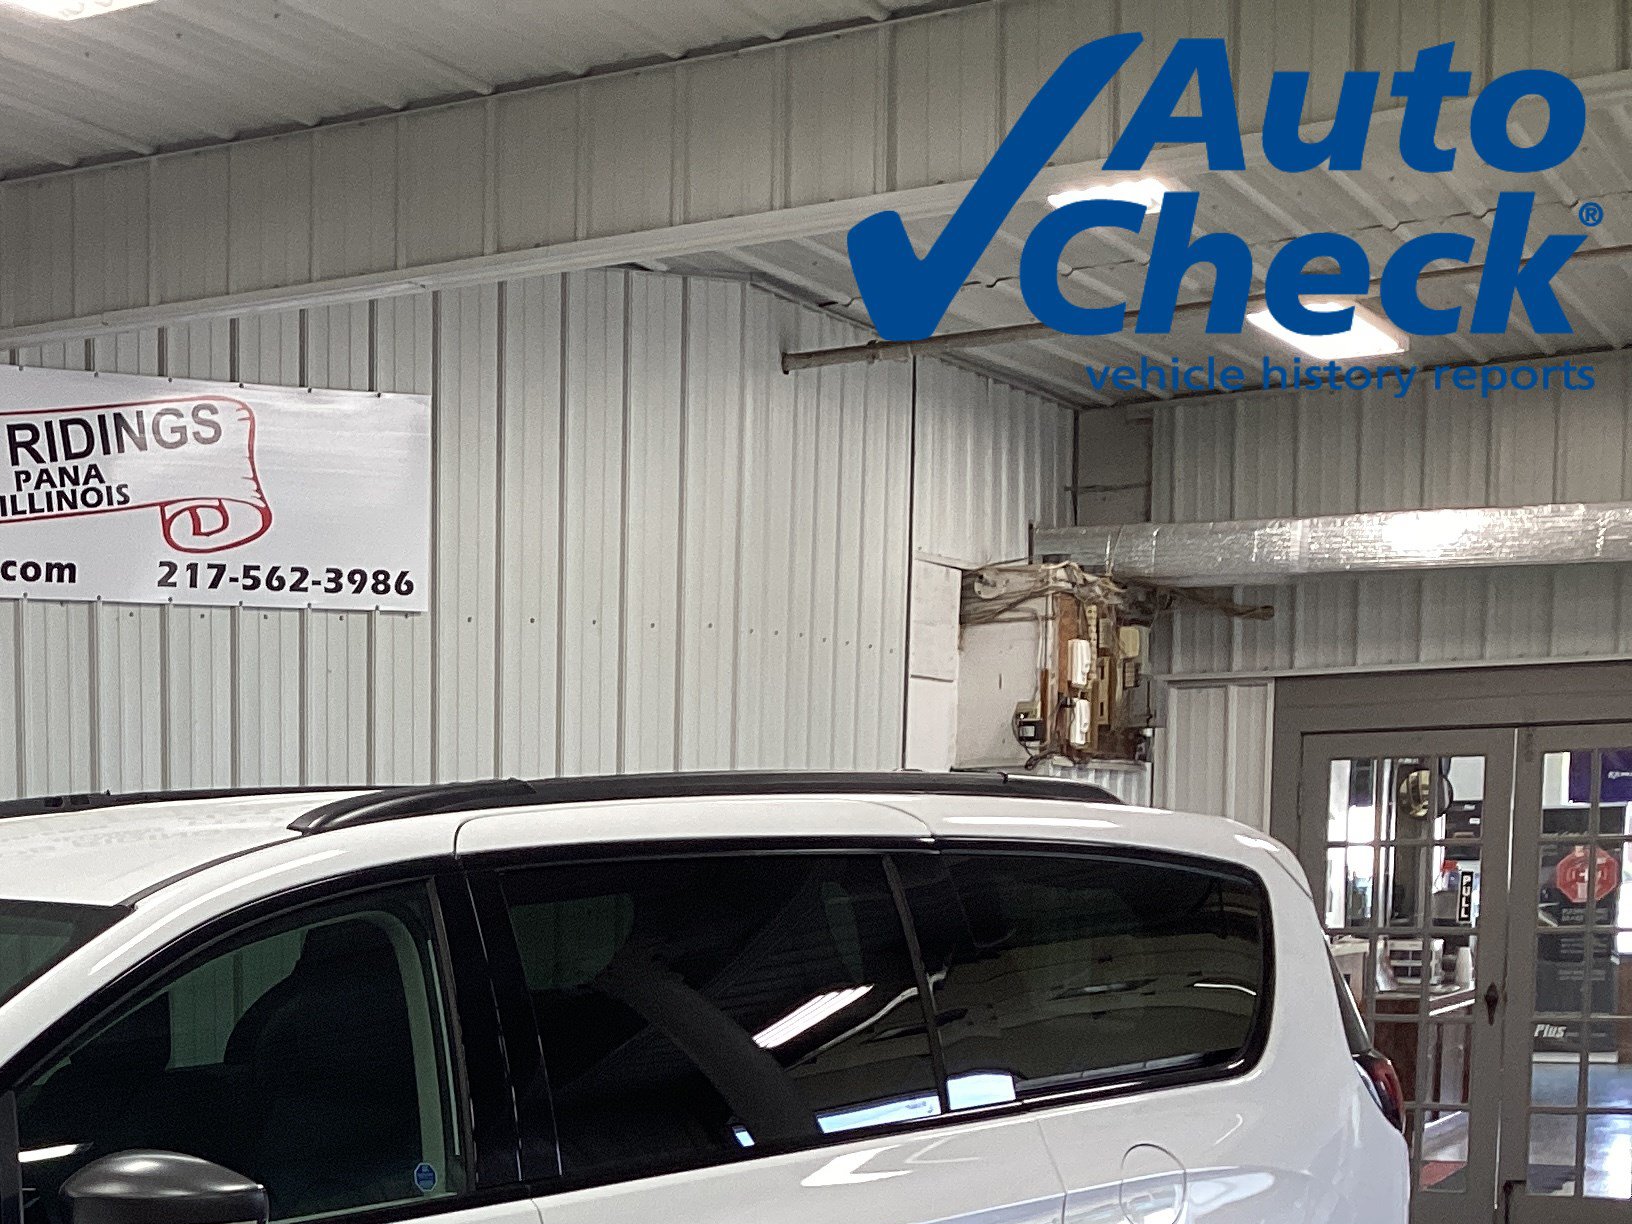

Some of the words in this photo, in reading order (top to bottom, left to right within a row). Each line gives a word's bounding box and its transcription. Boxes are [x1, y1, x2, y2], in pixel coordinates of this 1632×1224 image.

[6, 403, 223, 467] RIDINGS
[14, 463, 106, 492] PANA
[0, 484, 131, 517] ILLINOIS
[157, 560, 416, 597] 217-562-3986
[1460, 874, 1472, 918] PULL
[1534, 1024, 1566, 1043] Plus
